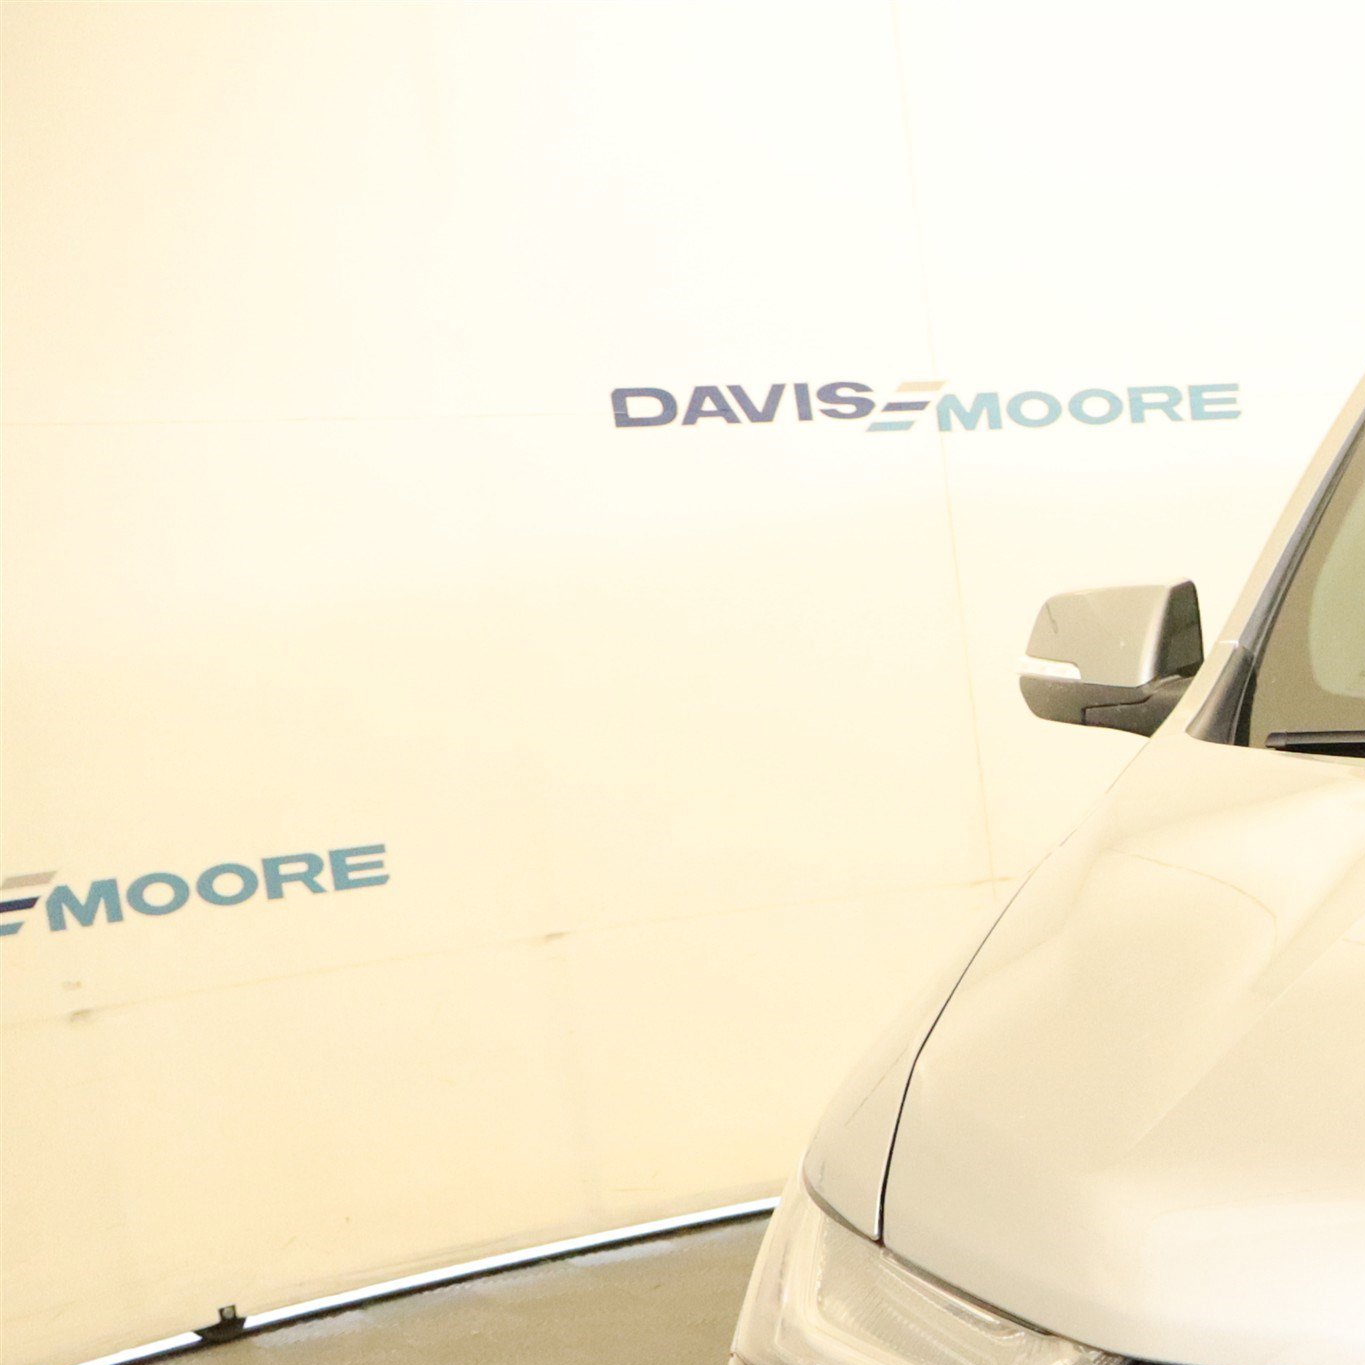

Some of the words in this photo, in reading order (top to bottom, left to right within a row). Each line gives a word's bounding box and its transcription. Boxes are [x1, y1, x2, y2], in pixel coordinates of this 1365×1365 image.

[610, 381, 876, 428] DAVIS
[936, 383, 1242, 433] MOORE
[46, 844, 390, 932] MOORE
